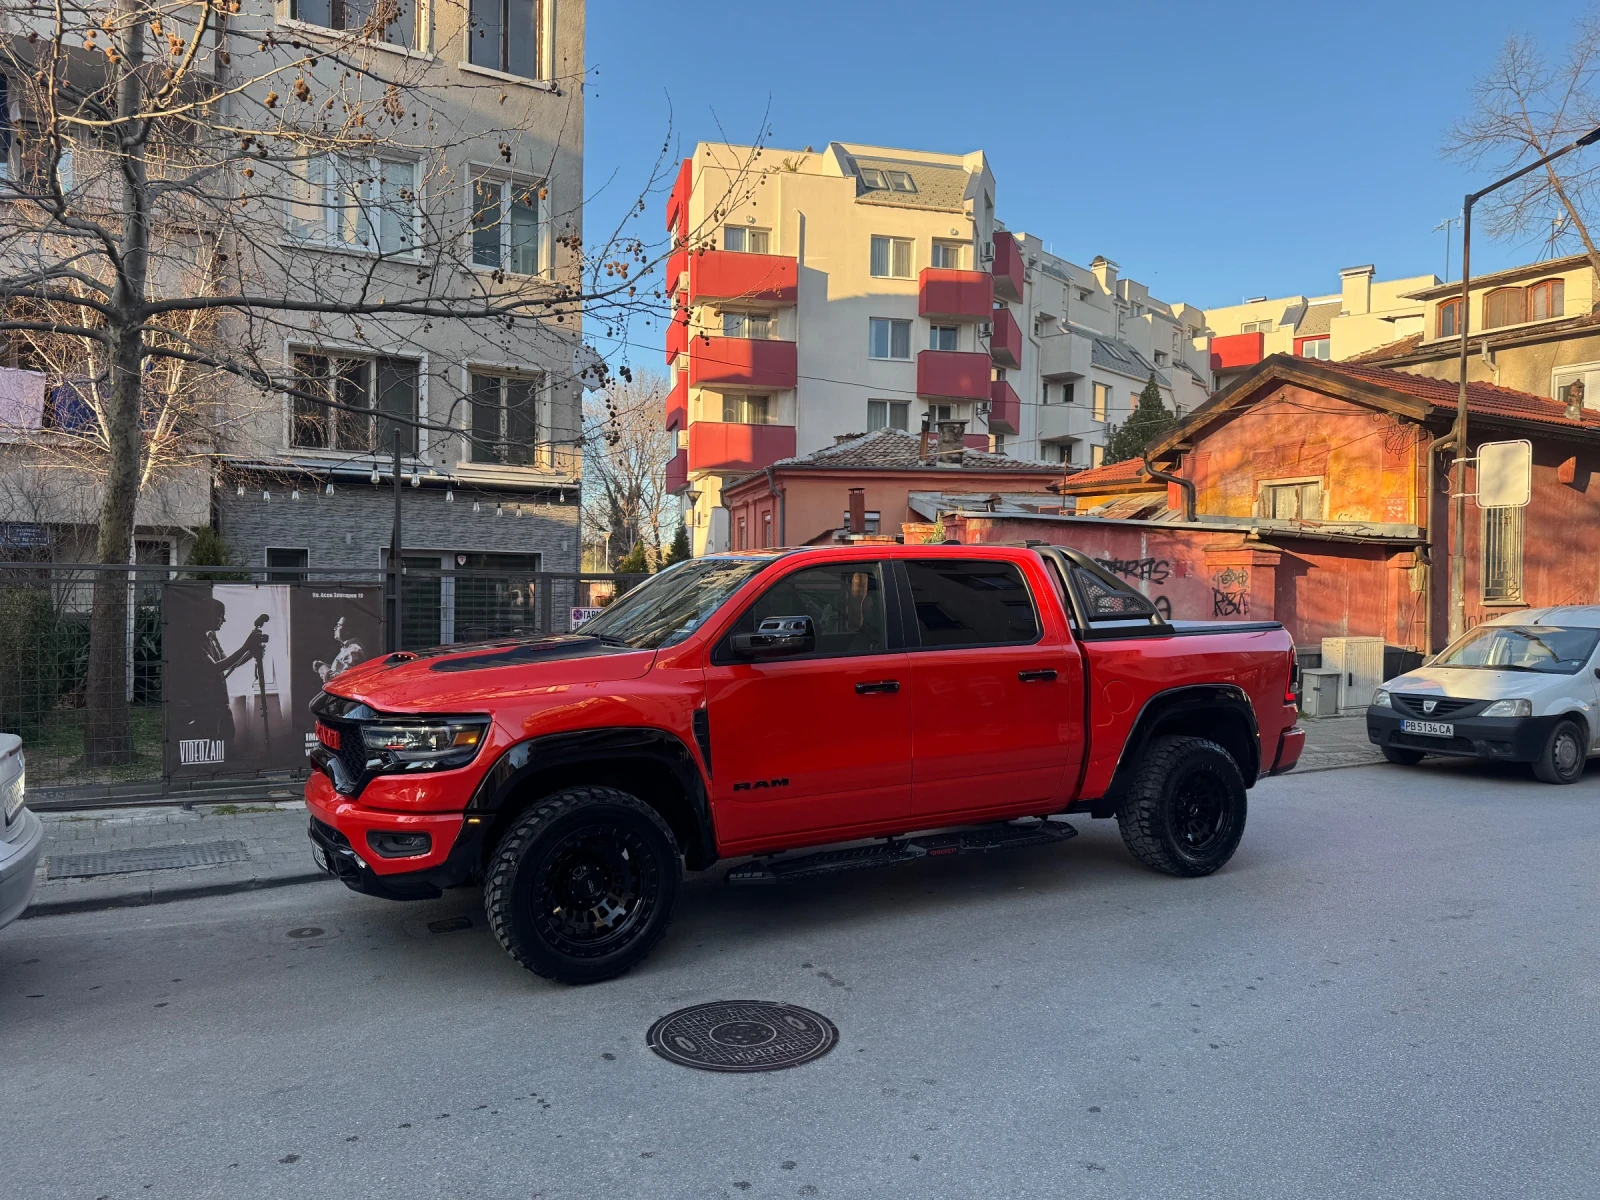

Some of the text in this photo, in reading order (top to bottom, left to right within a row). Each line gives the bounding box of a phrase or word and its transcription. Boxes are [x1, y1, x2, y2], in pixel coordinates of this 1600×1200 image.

[1406, 721, 1416, 731] PB
[1417, 722, 1437, 733] 5136
[733, 778, 789, 791] RAM
